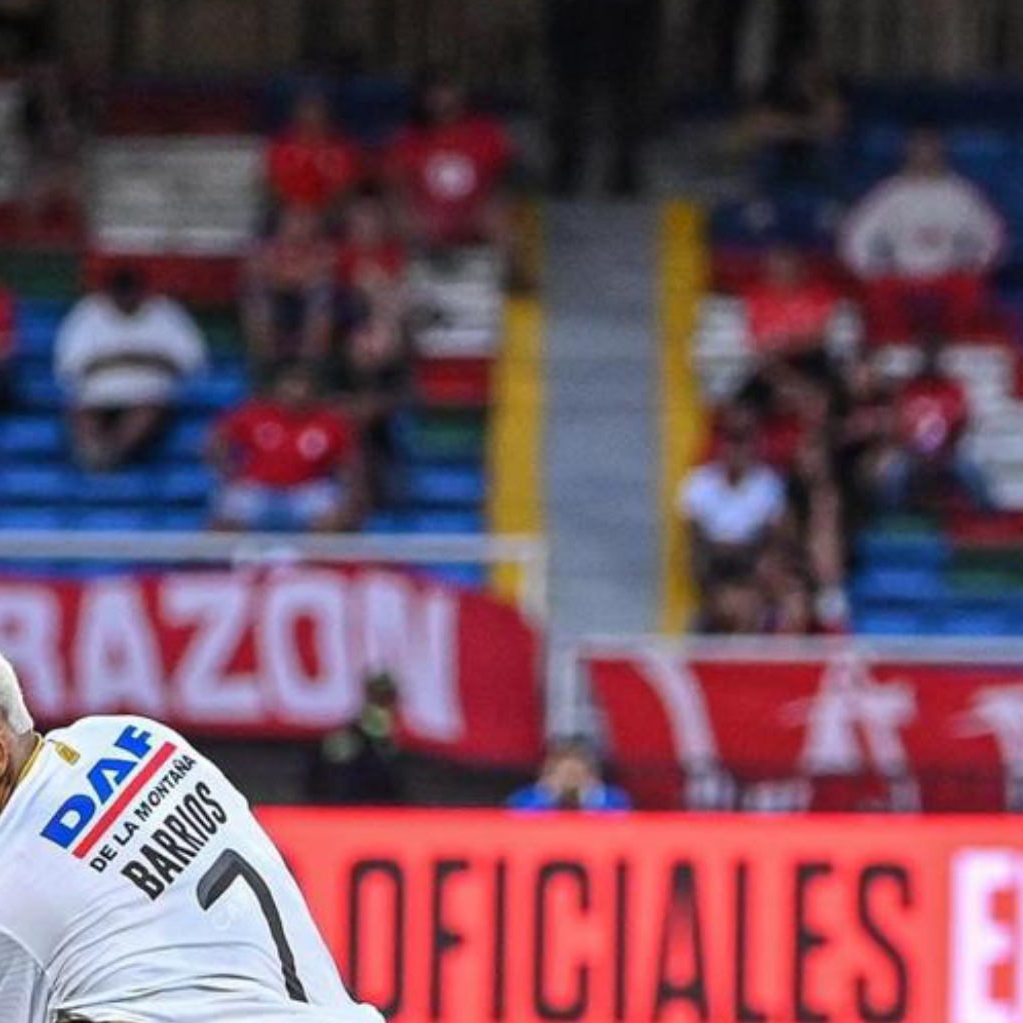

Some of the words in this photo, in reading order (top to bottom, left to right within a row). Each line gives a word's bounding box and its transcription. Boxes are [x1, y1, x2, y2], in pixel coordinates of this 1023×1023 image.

[40, 725, 153, 849] DAF
[89, 844, 118, 873] DE
[113, 821, 140, 846] LA
[134, 754, 197, 822] MONTAÑA
[120, 781, 227, 901] BARRIOS
[196, 848, 309, 1004] 7
